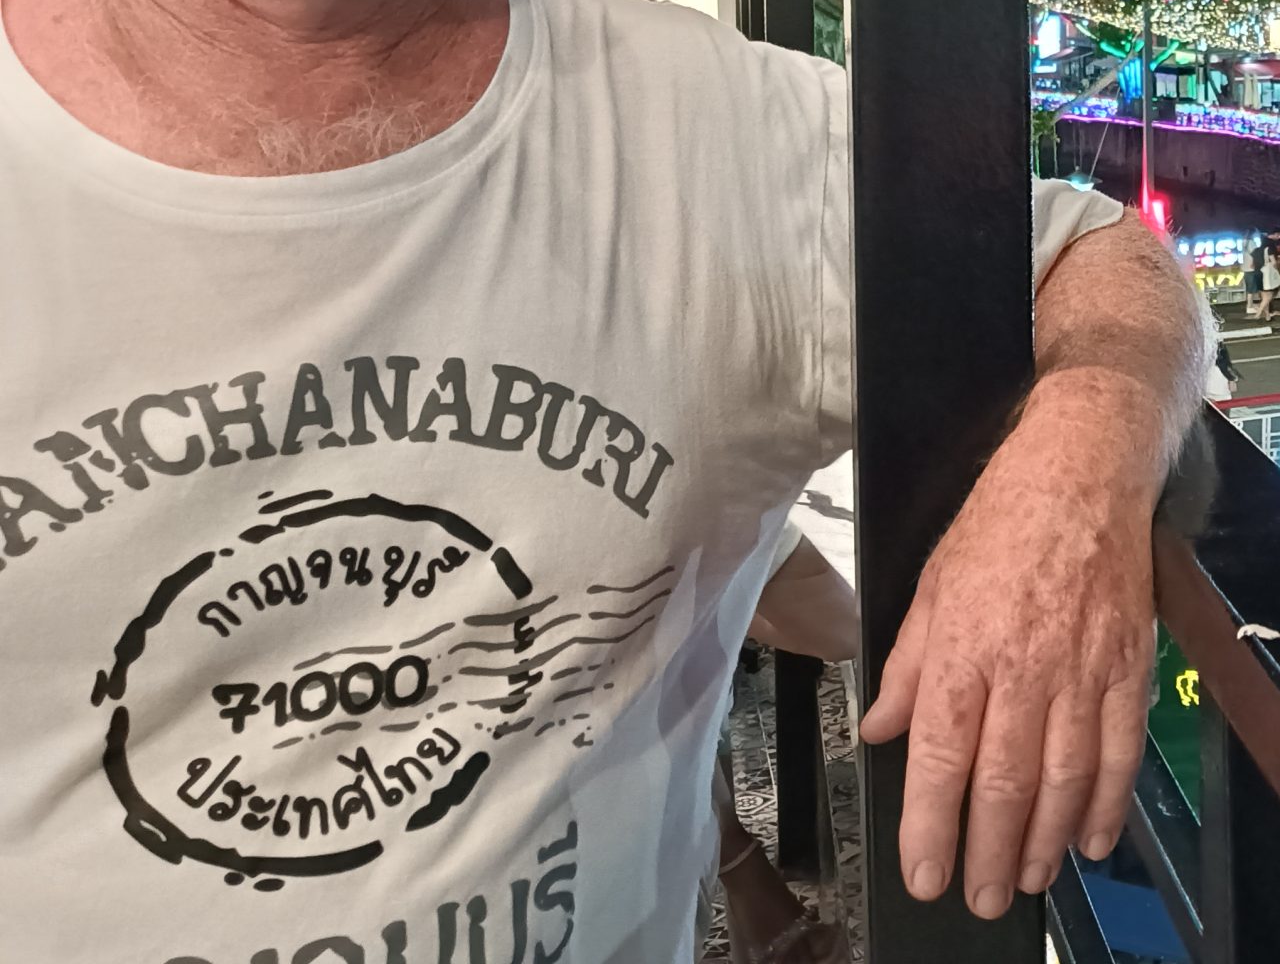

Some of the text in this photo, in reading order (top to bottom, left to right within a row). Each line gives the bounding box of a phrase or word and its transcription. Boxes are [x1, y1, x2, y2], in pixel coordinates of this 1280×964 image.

[0, 355, 675, 558] ANCHANABURI
[212, 654, 429, 734] 71000
[177, 727, 461, 839] ประเทศไทย
